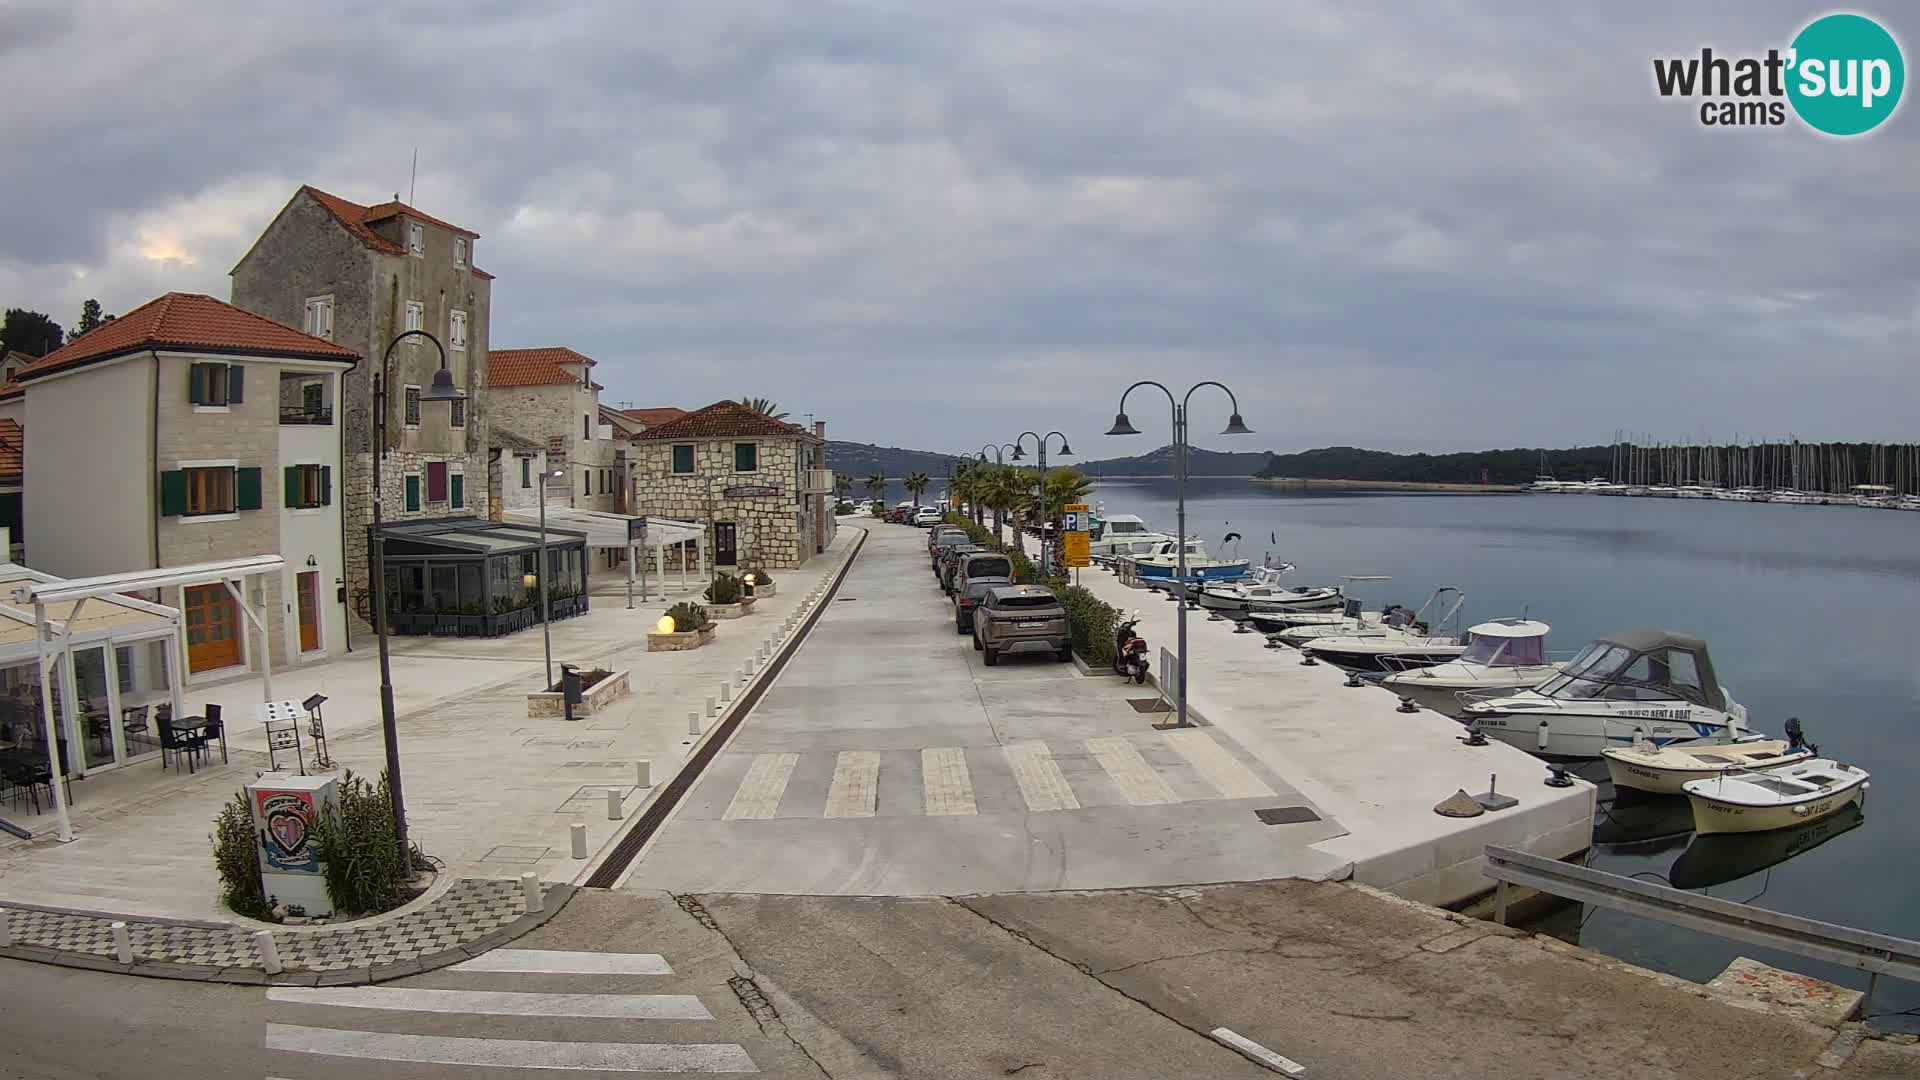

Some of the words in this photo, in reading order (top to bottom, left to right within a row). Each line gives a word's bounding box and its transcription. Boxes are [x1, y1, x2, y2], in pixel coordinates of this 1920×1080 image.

[1066, 514, 1076, 530] P
[1650, 709, 1668, 719] RENT
[1668, 709, 1674, 719] A
